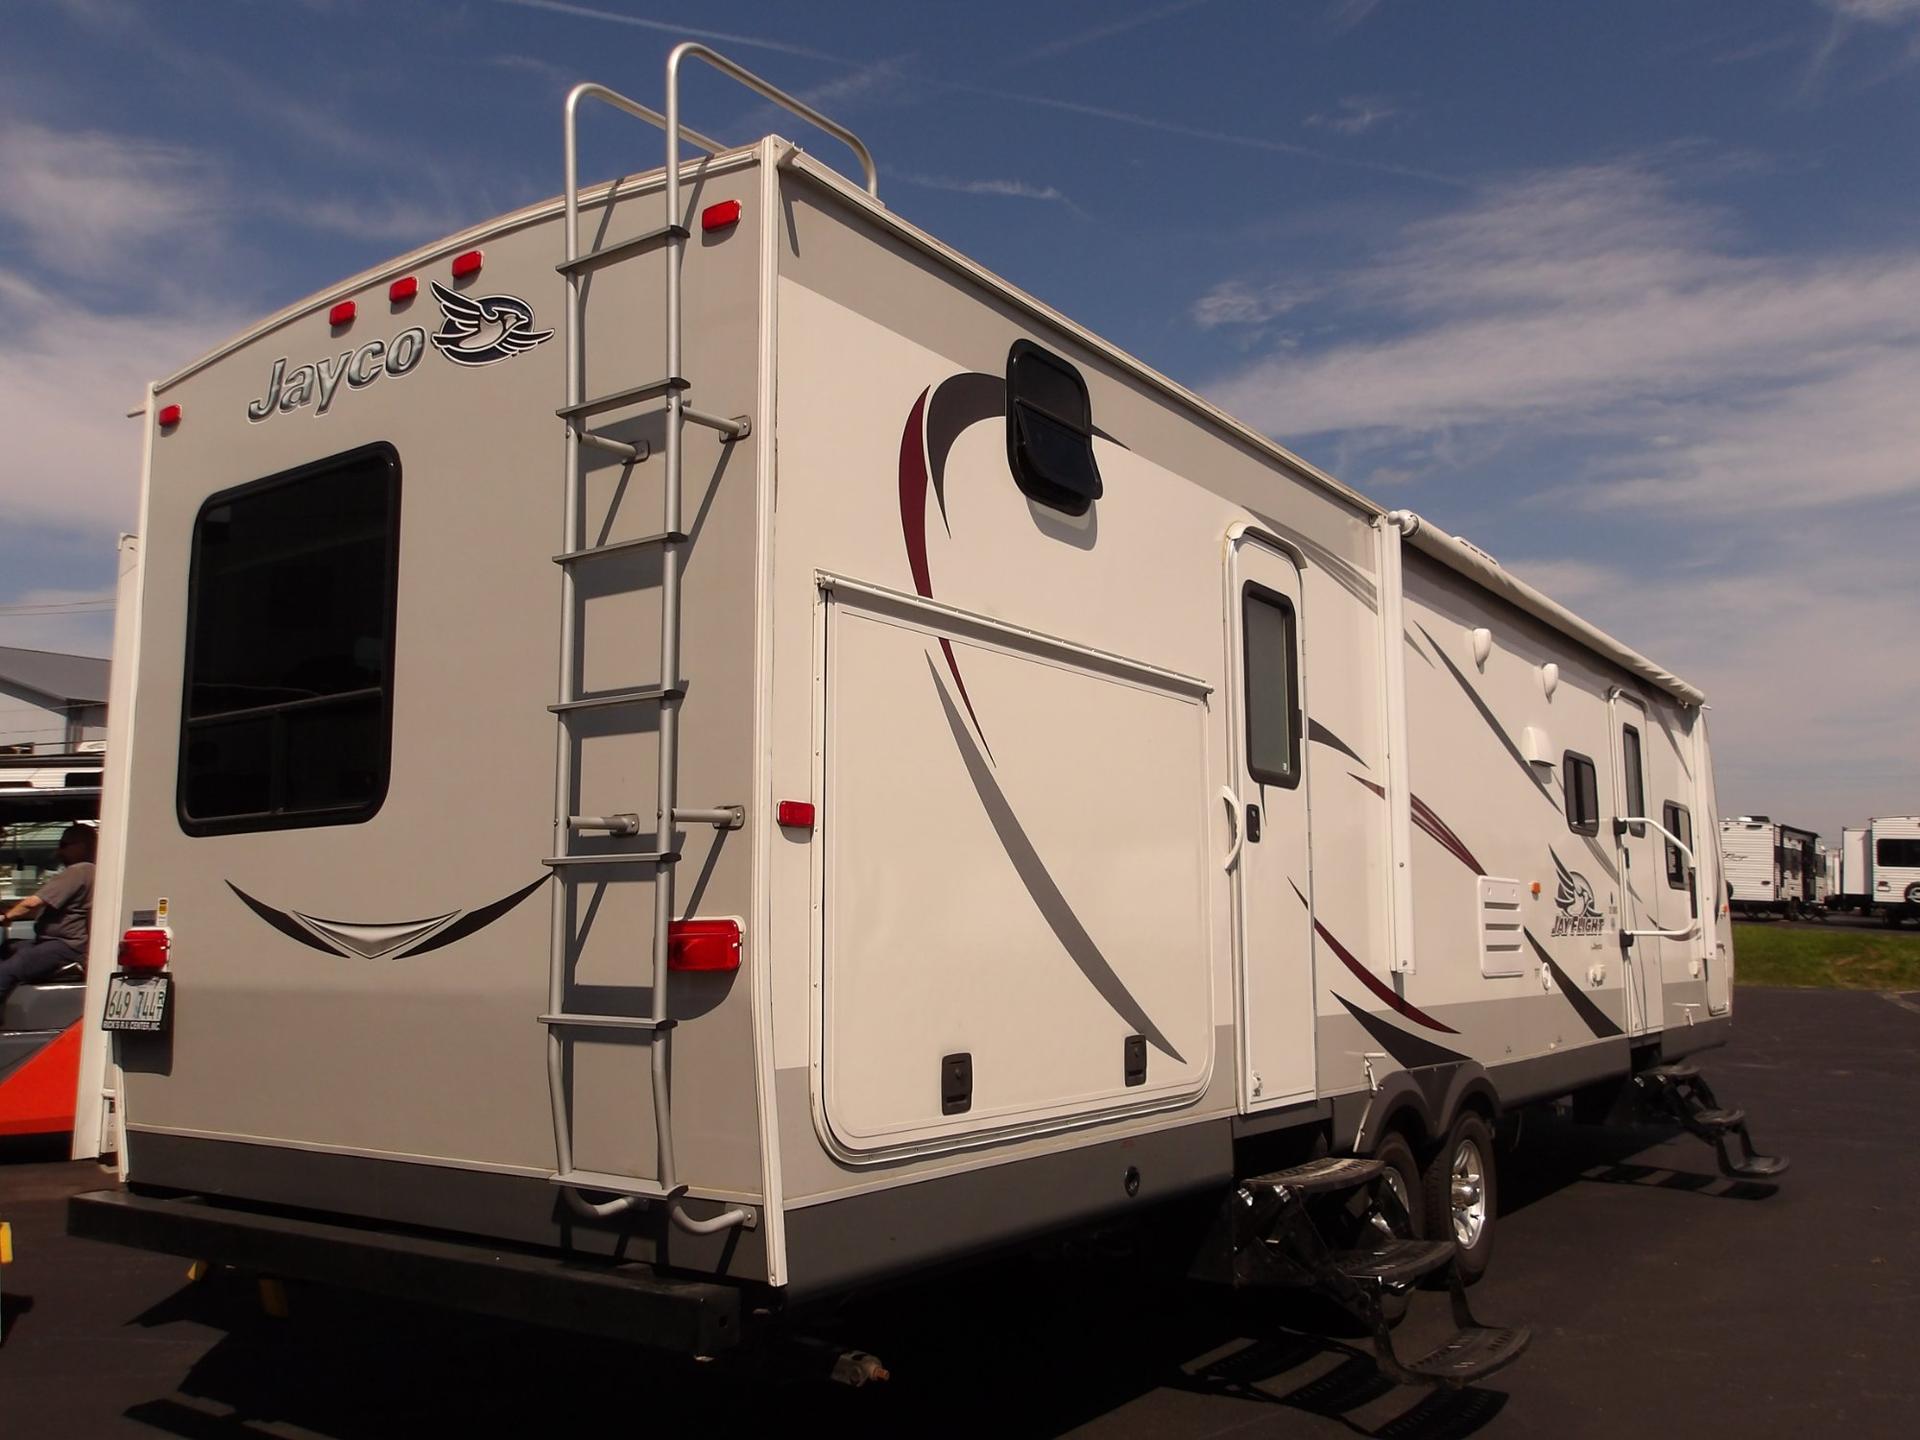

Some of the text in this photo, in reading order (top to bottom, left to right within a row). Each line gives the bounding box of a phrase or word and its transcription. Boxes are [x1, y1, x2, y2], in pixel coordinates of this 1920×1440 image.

[248, 326, 428, 424] Jayco
[1551, 915, 1604, 935] JAY FLIGHT
[108, 991, 156, 1019] 649 744
